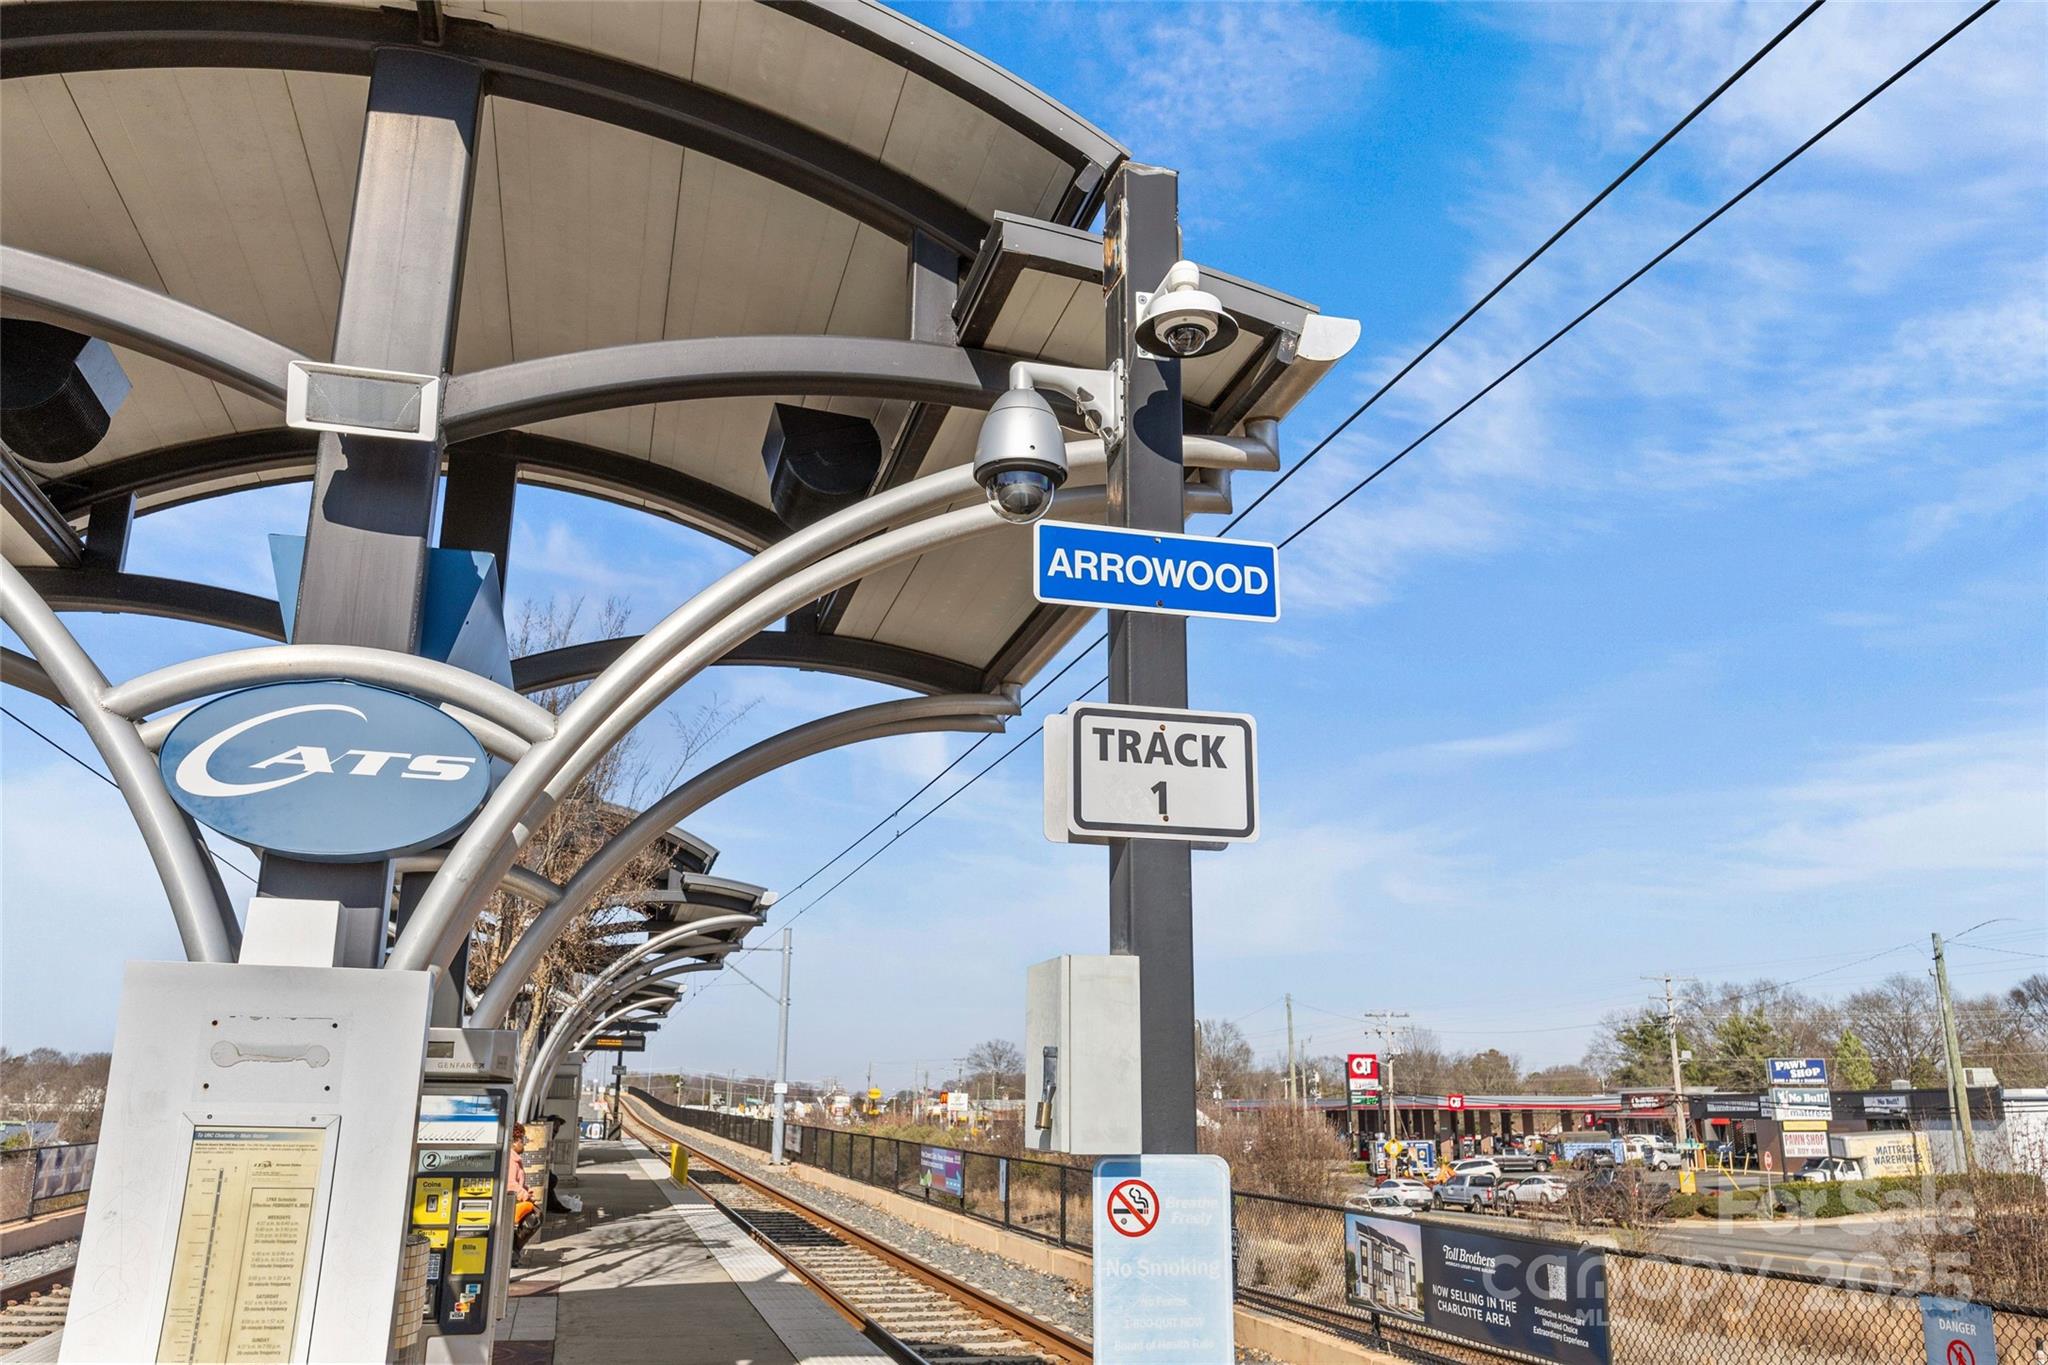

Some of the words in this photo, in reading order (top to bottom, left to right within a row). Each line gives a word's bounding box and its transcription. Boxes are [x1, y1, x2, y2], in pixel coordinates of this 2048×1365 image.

[1047, 547, 1268, 596] ARROWOOD
[175, 703, 477, 797] CATS
[1092, 727, 1228, 769] TRACK
[1150, 780, 1168, 815] 1
[1351, 1057, 1373, 1076] QT
[1774, 1060, 1807, 1071] PAWN
[1789, 1067, 1821, 1079] SHOP
[1788, 1093, 1802, 1102] No
[1803, 1092, 1829, 1103] Bull!
[1790, 1108, 1832, 1118] mattress
[1784, 1133, 1806, 1146] PAWN
[1806, 1133, 1825, 1146] SHOP
[426, 1154, 438, 1168] 2
[1166, 1196, 1218, 1209] Breathe
[1170, 1211, 1212, 1226] Freely
[1442, 1244, 1459, 1260] Toll
[1459, 1248, 1496, 1268] Brothers
[1105, 1259, 1132, 1278] No
[1137, 1258, 1222, 1280] Smoking
[1432, 1284, 1449, 1298] NOW
[1450, 1289, 1484, 1307] SELLING
[1486, 1296, 1497, 1309] IN
[1498, 1299, 1518, 1314] THE
[1437, 1300, 1483, 1321] CHARLOTTE
[1485, 1312, 1512, 1328] AREA
[1534, 1306, 1557, 1319] Distinctive
[1558, 1310, 1586, 1326] Architecture
[1562, 1324, 1578, 1335] Choice
[1938, 1318, 1977, 1336] DANGER
[1532, 1326, 1563, 1342] Extraordinary
[1563, 1334, 1590, 1348] Experience
